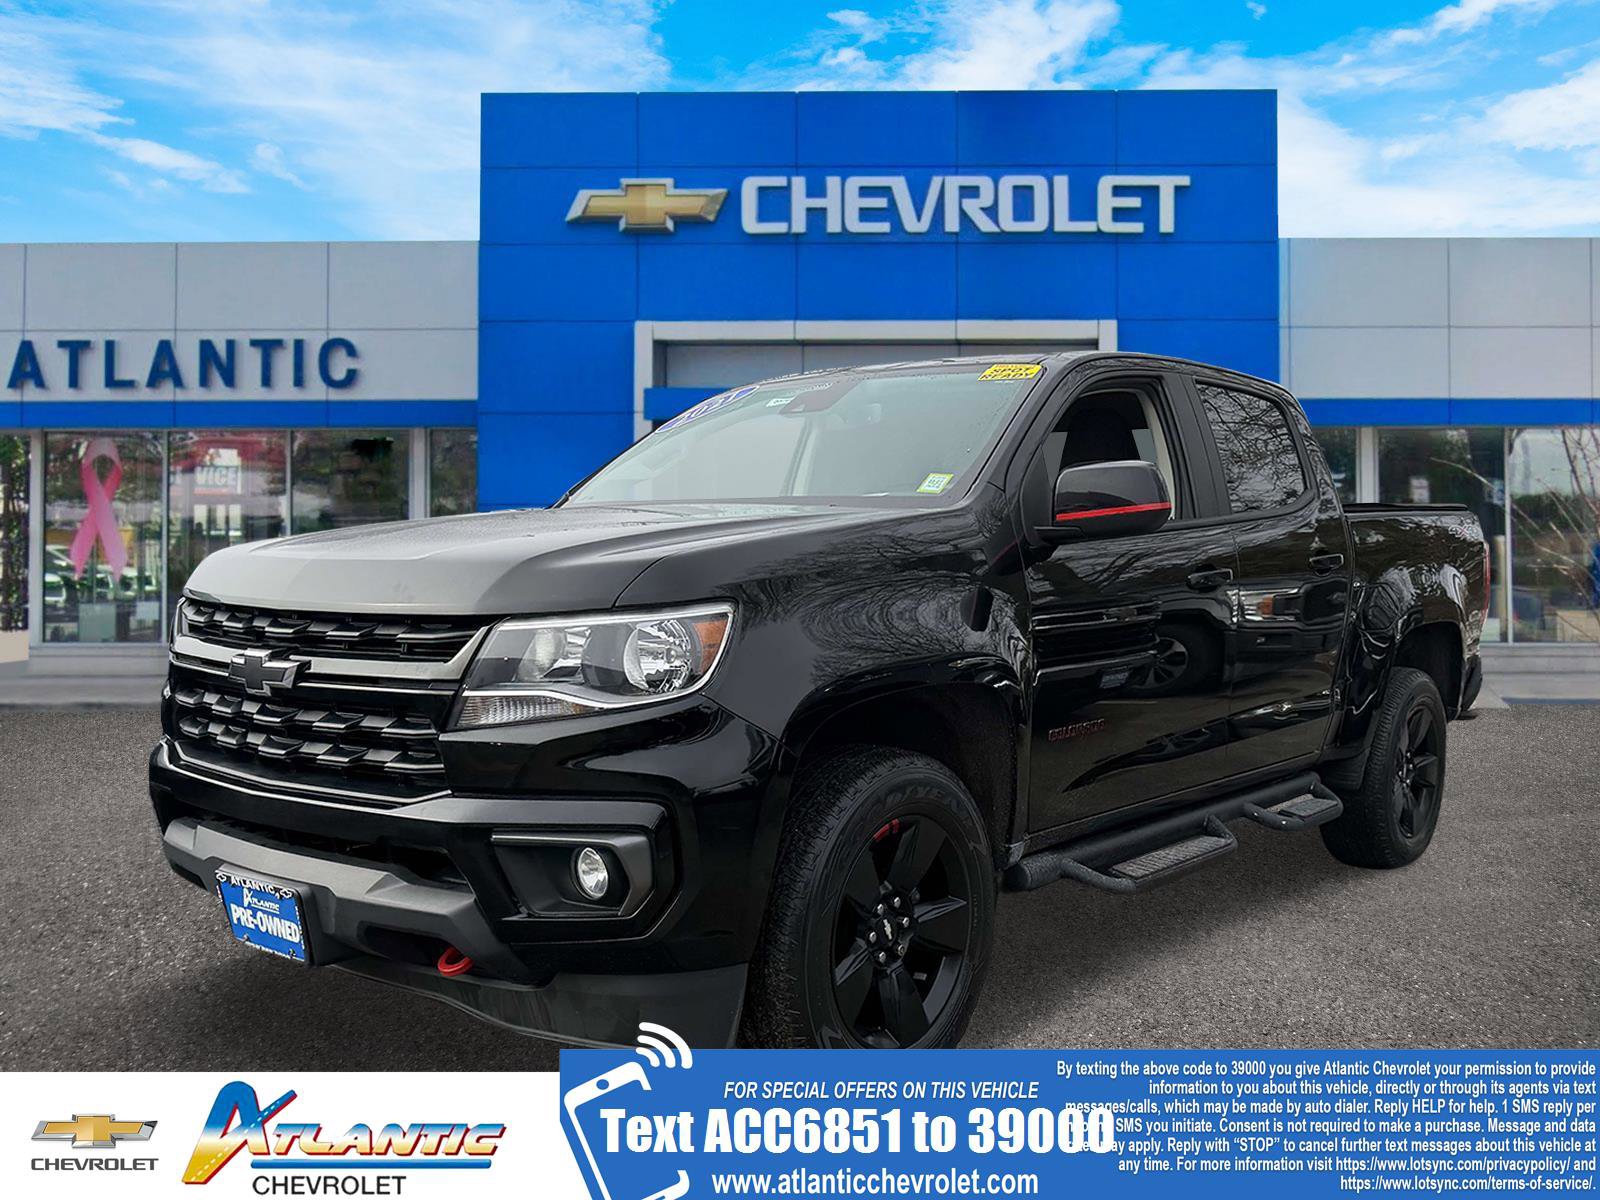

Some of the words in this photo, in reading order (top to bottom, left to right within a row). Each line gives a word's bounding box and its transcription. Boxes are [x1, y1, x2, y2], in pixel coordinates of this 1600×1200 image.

[741, 175, 1191, 234] CHEVROLET
[7, 337, 360, 390] ATLANTIC
[230, 902, 300, 944] PRE-OWNED
